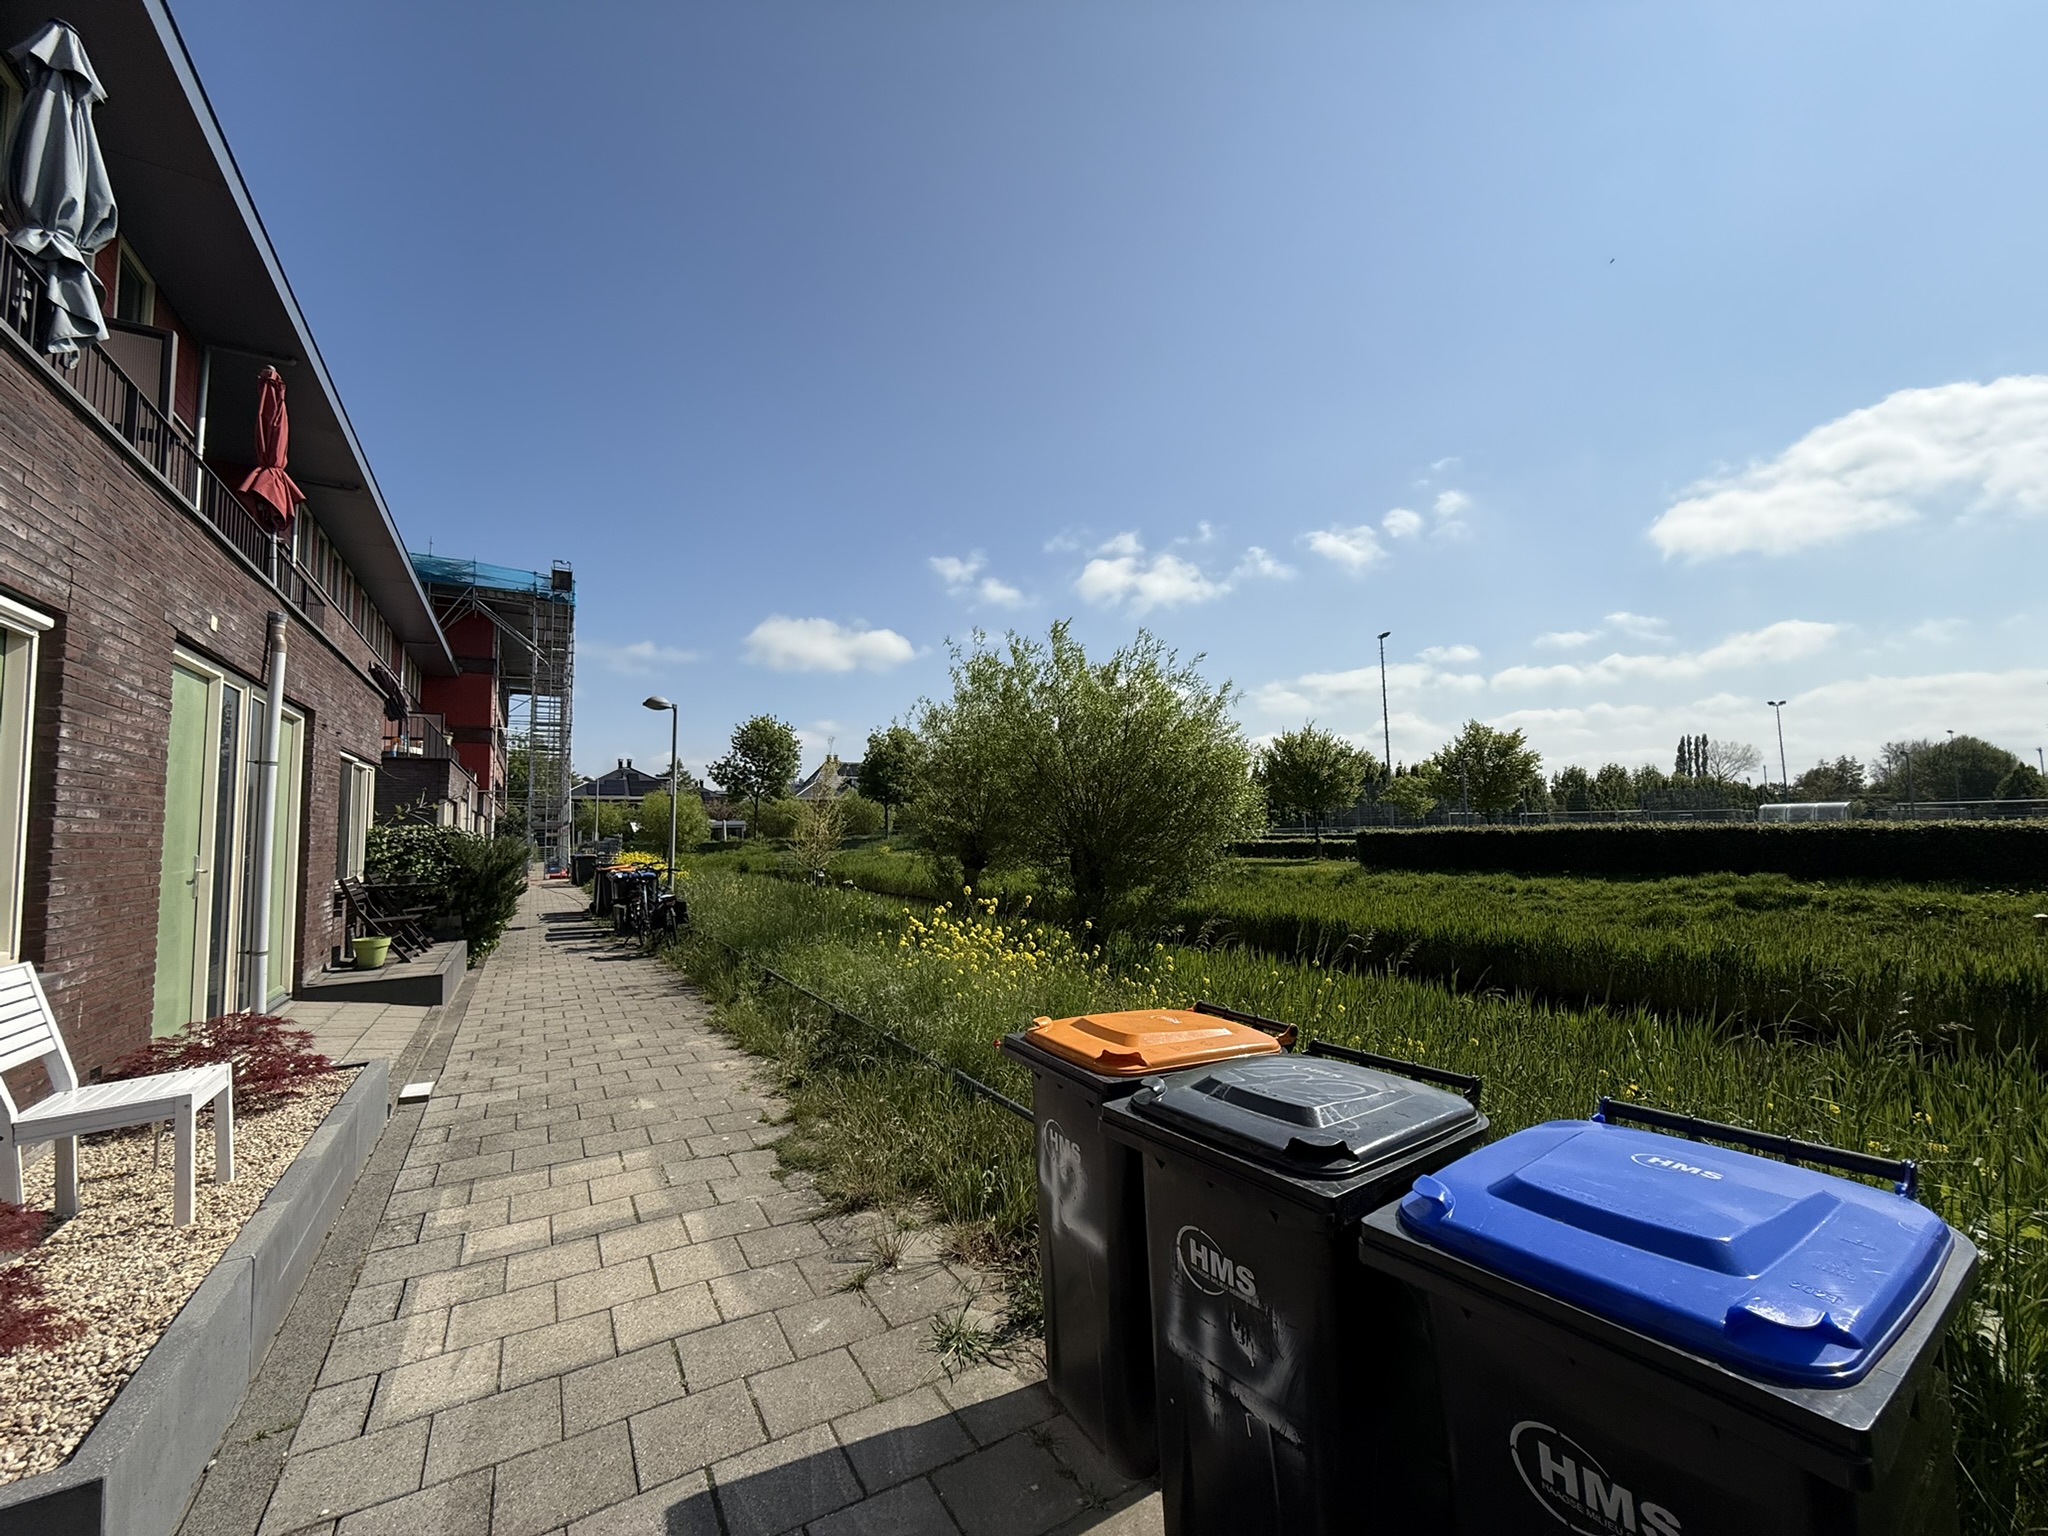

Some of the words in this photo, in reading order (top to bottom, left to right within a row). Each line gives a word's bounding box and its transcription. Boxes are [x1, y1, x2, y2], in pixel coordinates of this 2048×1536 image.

[1050, 1128, 1082, 1162] HMS
[1647, 1157, 1724, 1180] HMS
[1189, 1237, 1256, 1297] HMS
[1541, 1481, 1585, 1515] HAAGSE
[1585, 1508, 1624, 1536] MILIEU
